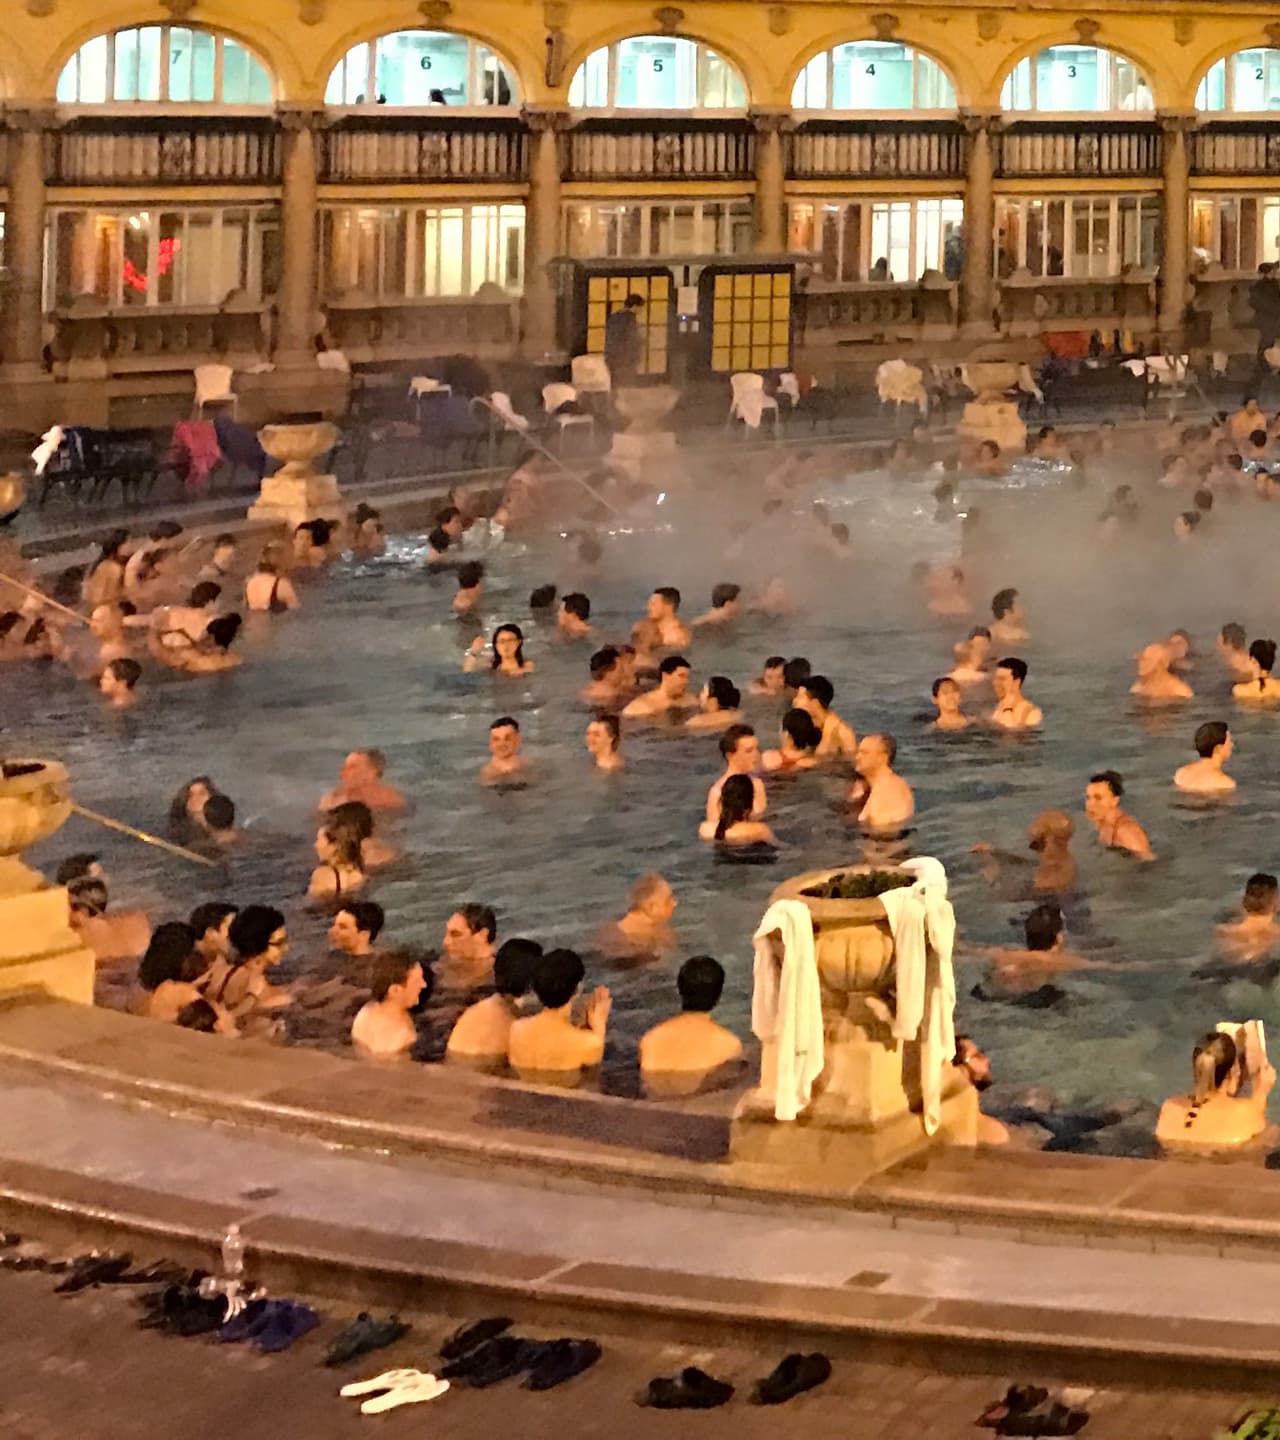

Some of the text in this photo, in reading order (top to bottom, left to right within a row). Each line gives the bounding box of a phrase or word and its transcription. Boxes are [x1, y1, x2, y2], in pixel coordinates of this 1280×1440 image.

[171, 50, 183, 64] 7
[420, 56, 432, 70] 6
[653, 59, 664, 72] 5
[865, 63, 876, 76] 4
[1068, 66, 1077, 78] 3
[1255, 68, 1264, 80] 2
